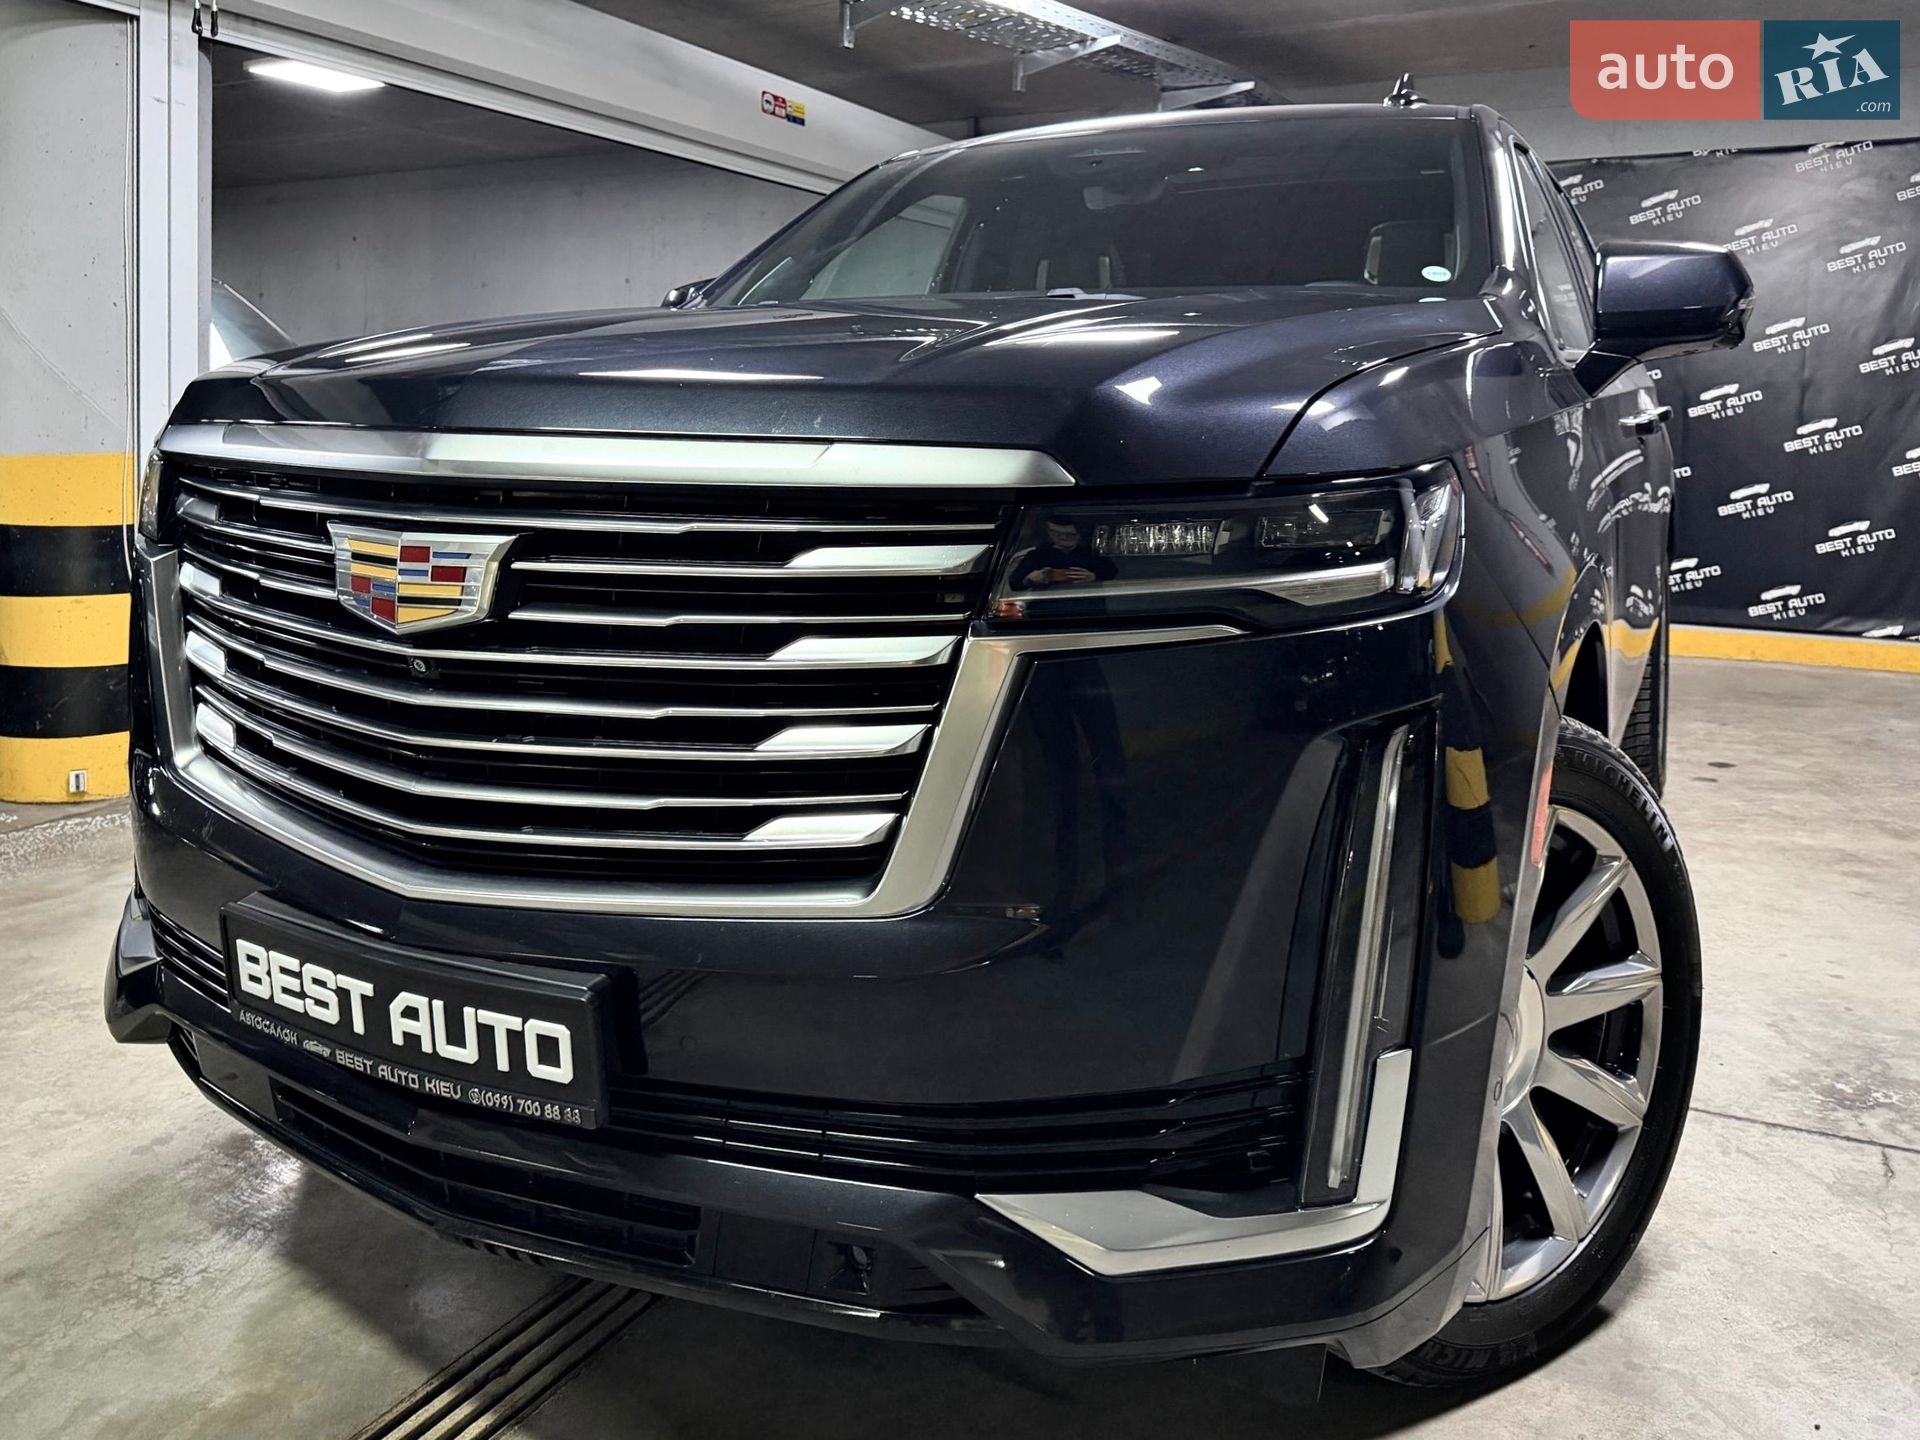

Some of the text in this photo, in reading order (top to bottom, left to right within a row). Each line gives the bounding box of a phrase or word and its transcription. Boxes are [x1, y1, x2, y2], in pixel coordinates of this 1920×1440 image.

[1795, 140, 1874, 173] BEST AUTO
[1570, 179, 1604, 197] AUTO
[1629, 194, 1702, 225] BEST AUTO
[1761, 223, 1798, 241] AUTO
[1826, 241, 1907, 273] BEST AUTO
[1752, 323, 1831, 352] BEST AUTO
[1858, 349, 1920, 374] BEST AU
[1687, 390, 1763, 418] BEST AUTO
[1783, 424, 1863, 452] BEST AUTO
[1891, 461, 1920, 477] BES
[1717, 490, 1794, 517] BEST AUTO
[1815, 528, 1896, 554] BEST AUTO
[1685, 565, 1722, 581] AUTO
[1747, 593, 1826, 617] BEST AUTO
[235, 938, 575, 1085] BEST AUTO
[335, 1048, 374, 1075] BEST
[378, 1064, 420, 1089] AUTO
[481, 1089, 514, 1113] (099)
[517, 1099, 541, 1117] 700
[544, 1103, 561, 1121] 88
